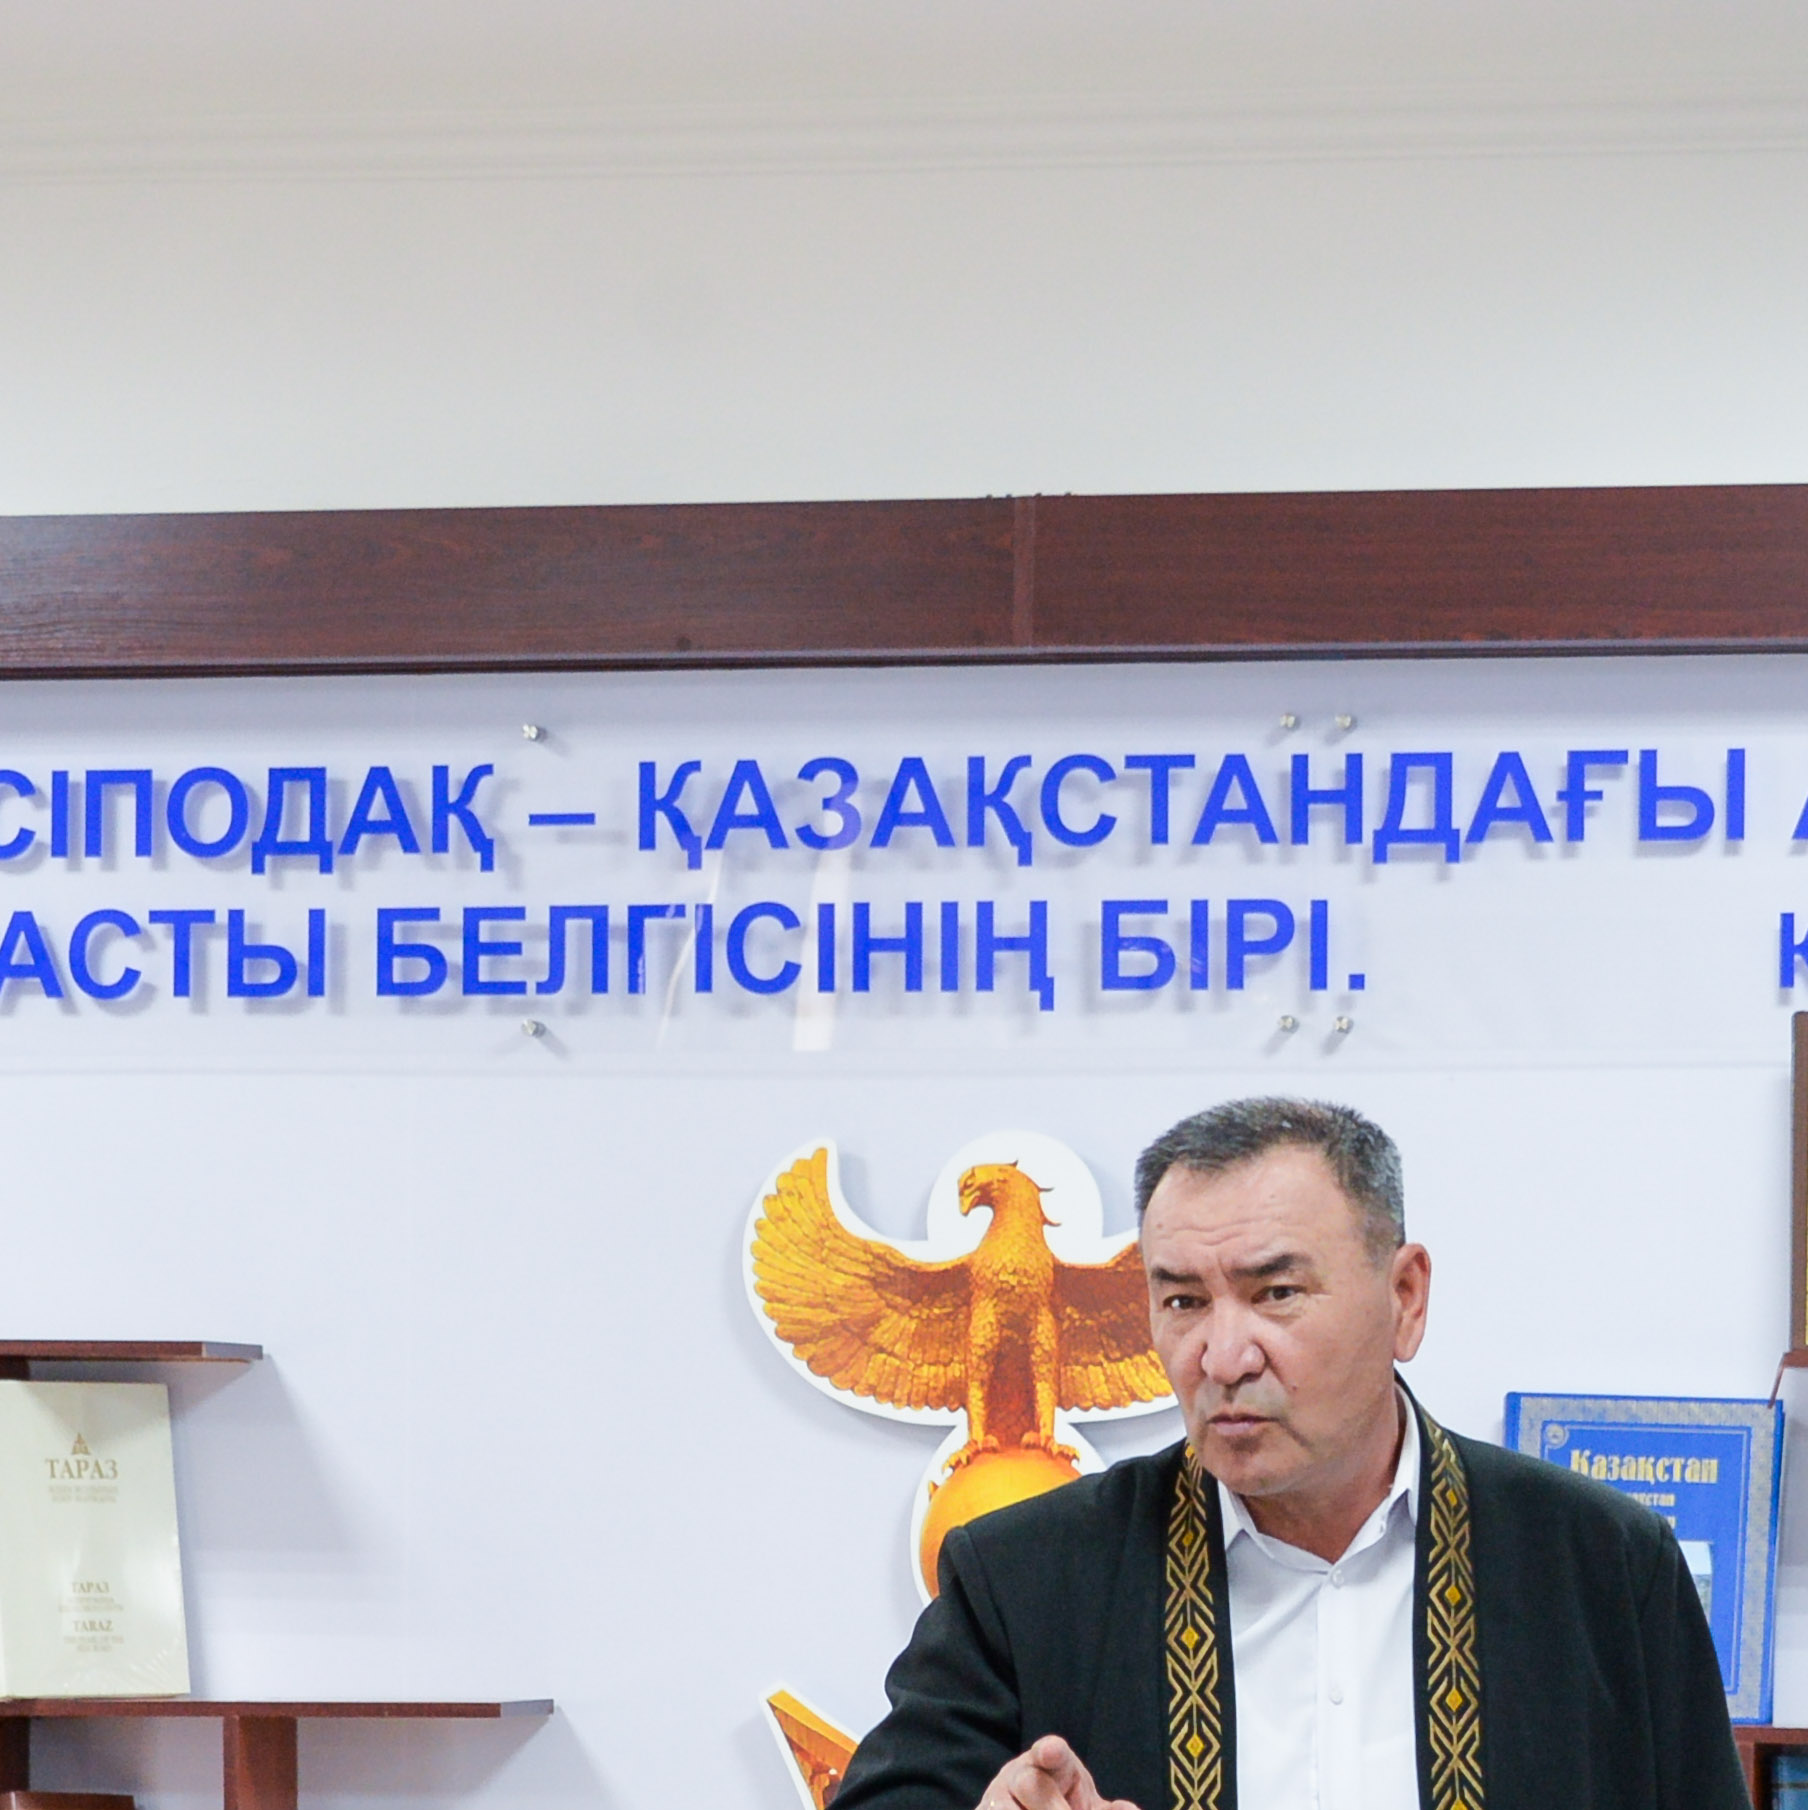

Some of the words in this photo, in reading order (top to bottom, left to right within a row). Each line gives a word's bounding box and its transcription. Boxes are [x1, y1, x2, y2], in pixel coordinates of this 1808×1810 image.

[638, 747, 1746, 871] ҚАЗАҚСТАНДАҒЫ
[375, 898, 1056, 1012] БЕЛГІСІНІҢ
[1100, 896, 1366, 993] БІРІ.
[45, 1458, 119, 1480] ТАРАЗ
